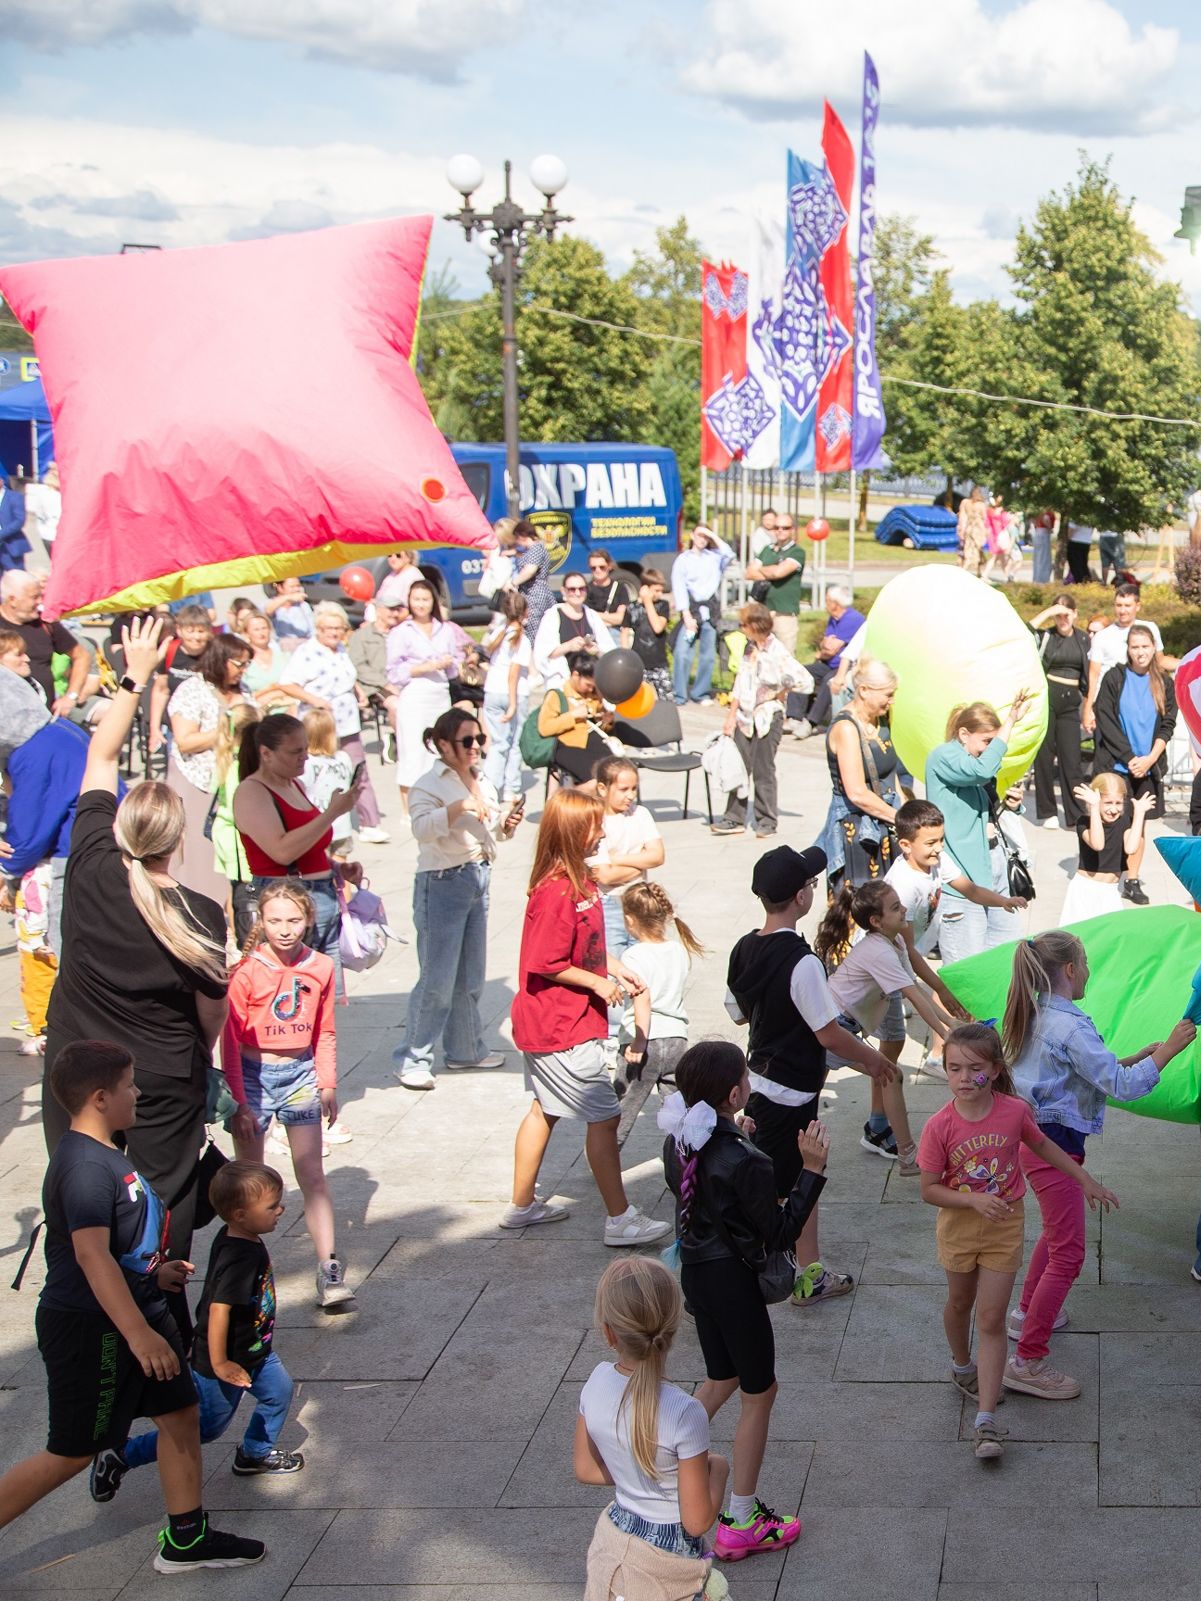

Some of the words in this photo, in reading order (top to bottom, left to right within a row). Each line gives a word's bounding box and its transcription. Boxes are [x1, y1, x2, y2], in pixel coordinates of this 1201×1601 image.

[504, 463, 667, 511] ОХРАНА
[265, 1025, 286, 1036] Tik
[291, 1022, 312, 1034] Tok
[949, 1133, 1008, 1166] BUTTERFLY
